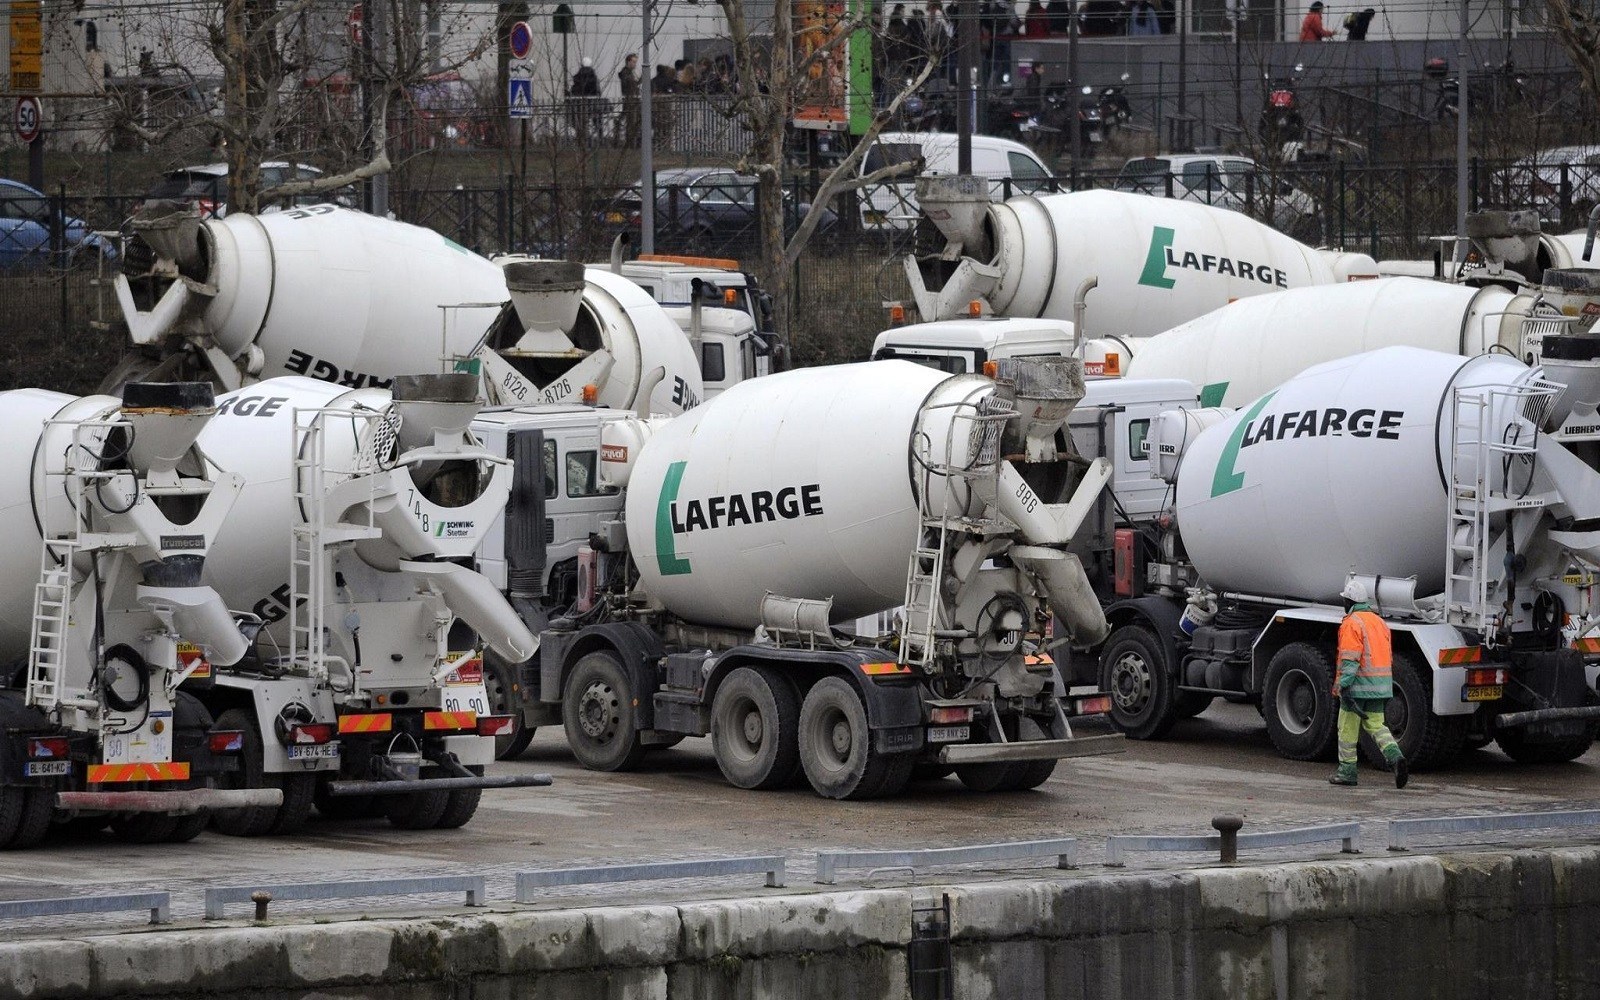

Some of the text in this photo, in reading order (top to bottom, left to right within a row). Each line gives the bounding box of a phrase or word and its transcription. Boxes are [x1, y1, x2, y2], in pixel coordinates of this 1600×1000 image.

[20, 106, 35, 127] 50
[1166, 247, 1288, 289] LAFARGE
[504, 372, 572, 403] 8726 8726
[216, 396, 290, 417] RGE
[1240, 408, 1404, 449] LAFARGE
[670, 483, 824, 534] LAFARGE
[1016, 483, 1037, 513] 986
[162, 538, 205, 548] frumecar
[447, 529, 468, 537] Stetter
[446, 698, 484, 714] 80 90
